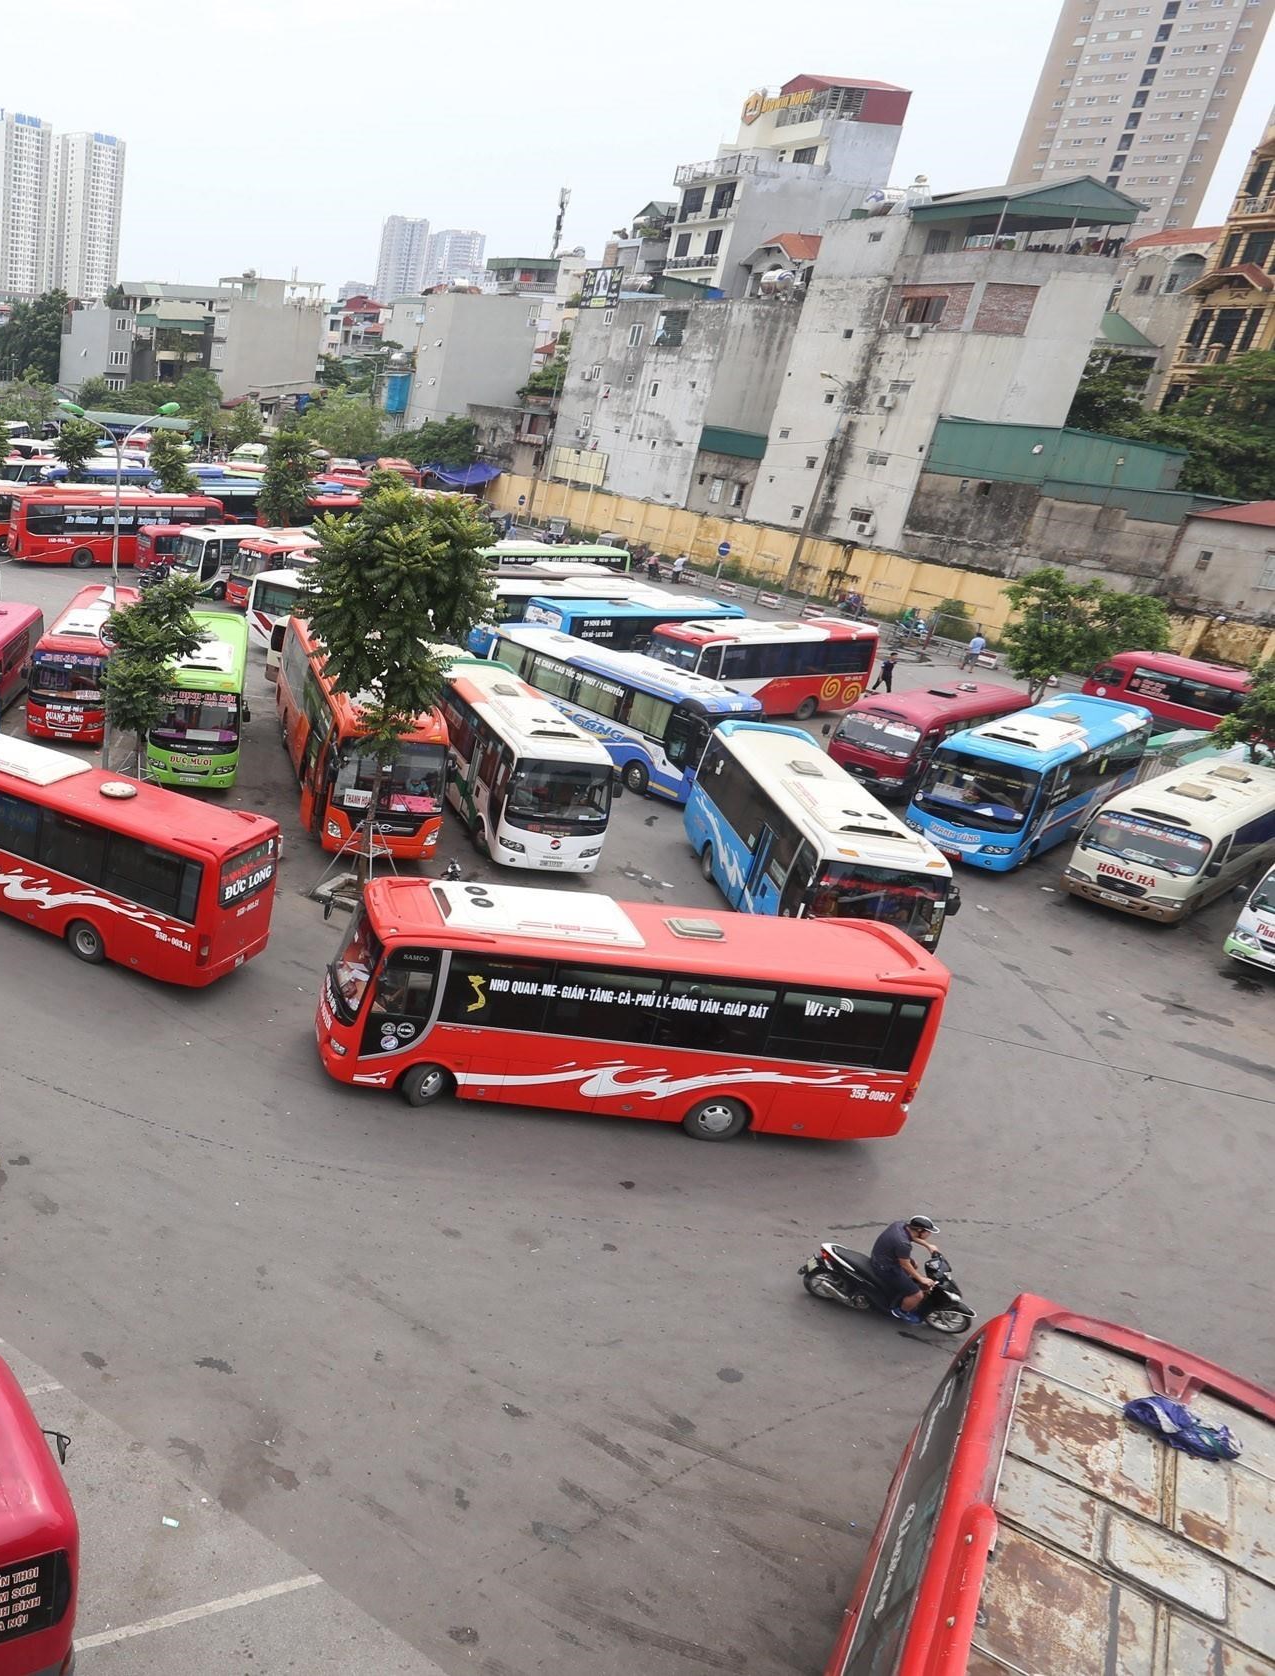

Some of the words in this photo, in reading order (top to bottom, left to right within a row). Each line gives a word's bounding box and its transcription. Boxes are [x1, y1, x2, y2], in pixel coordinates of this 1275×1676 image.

[729, 703, 743, 712] VIP
[267, 839, 274, 855] P
[225, 880, 247, 900] ĐỨC
[248, 865, 272, 888] LONG
[403, 953, 430, 962] SAMCO
[489, 978, 510, 992] NHO
[748, 1003, 769, 1019] BÁT
[12, 1566, 40, 1584] THOI
[11, 1583, 37, 1599] SƠN
[12, 1596, 41, 1614] BÌNH
[7, 1614, 29, 1629] NỘI
